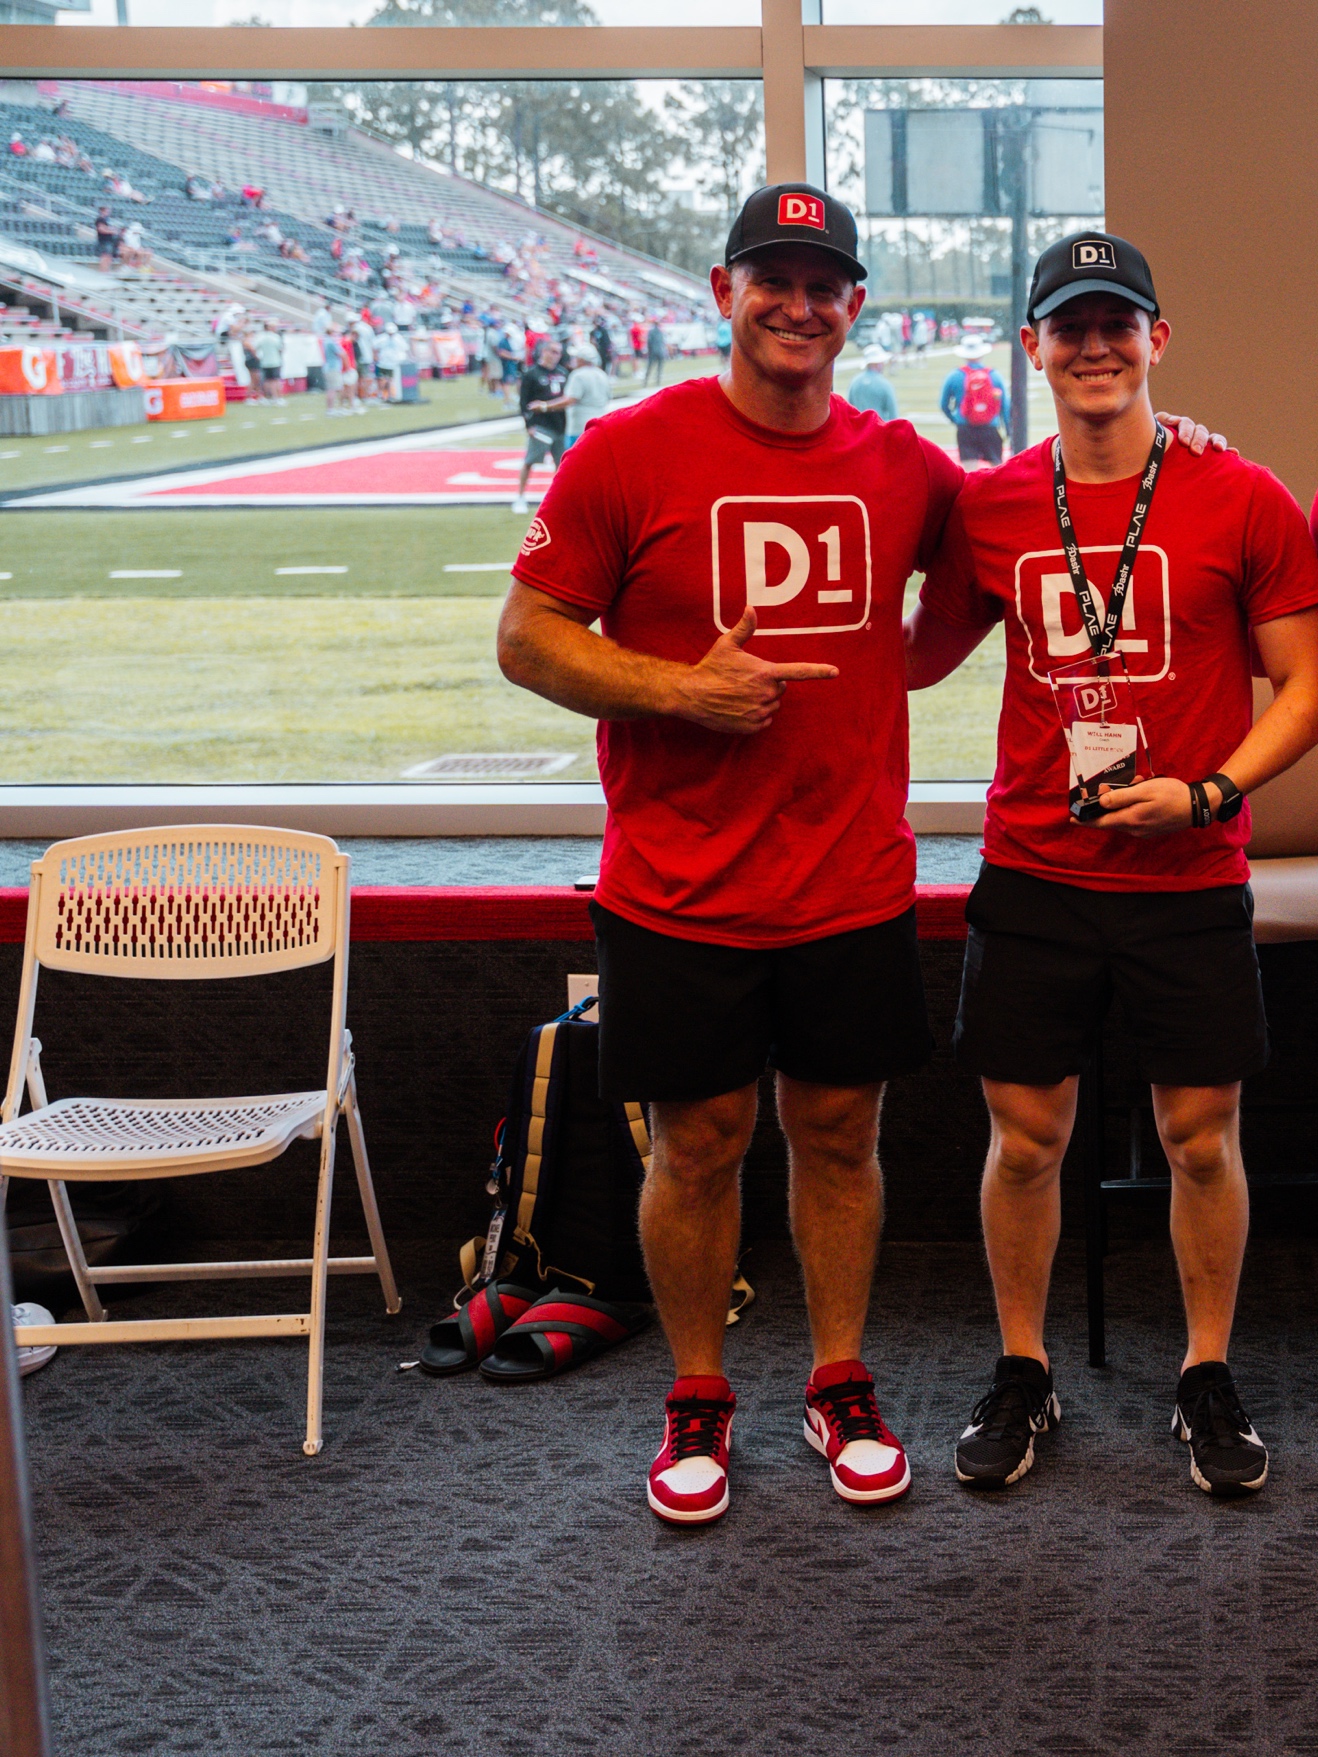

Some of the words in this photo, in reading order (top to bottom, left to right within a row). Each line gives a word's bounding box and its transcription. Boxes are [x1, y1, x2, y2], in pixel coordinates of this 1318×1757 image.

[786, 198, 820, 223] D1
[1080, 245, 1110, 264] D1
[1111, 563, 1130, 597] Dashr
[1125, 503, 1147, 548] PLAE
[1141, 460, 1159, 491] Dashr
[743, 521, 853, 607] D1
[1056, 484, 1071, 528] PLAE
[1066, 542, 1081, 575] Dashr
[1079, 590, 1101, 637] PLAE
[1041, 572, 1149, 657] D1
[1080, 686, 1112, 710] D1
[1103, 762, 1126, 774] AWARD
